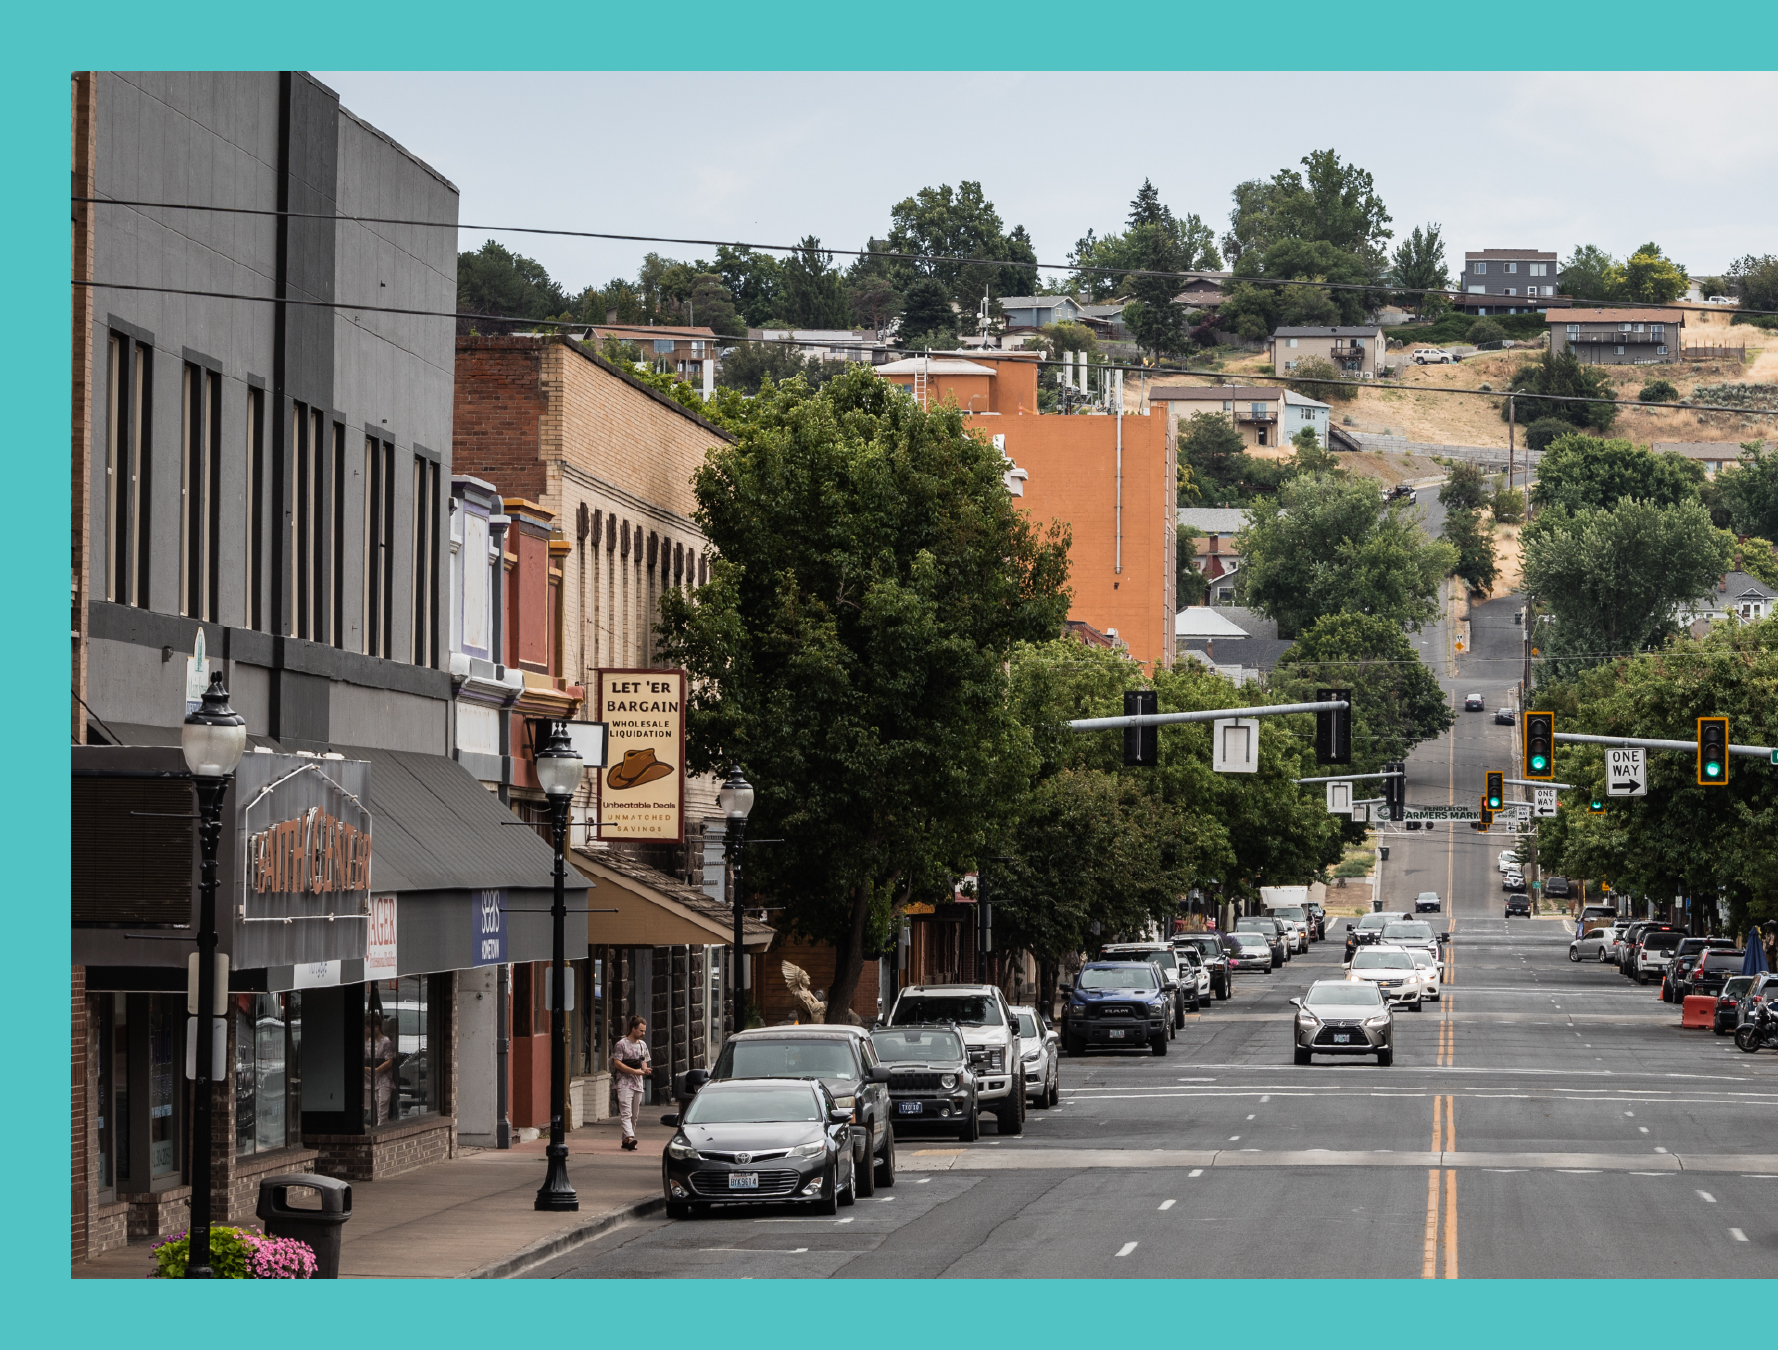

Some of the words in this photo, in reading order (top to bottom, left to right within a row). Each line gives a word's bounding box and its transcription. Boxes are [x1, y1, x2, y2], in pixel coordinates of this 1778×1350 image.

[612, 682, 641, 693] LET
[647, 681, 671, 693] 'ER
[607, 701, 678, 712] BARGAIN
[609, 730, 672, 738] LIQUIDATION
[1612, 751, 1640, 762] ONE
[1612, 765, 1640, 776] WAY
[258, 813, 306, 893] FAITH
[312, 805, 371, 894] CENTER
[482, 890, 499, 934] sears
